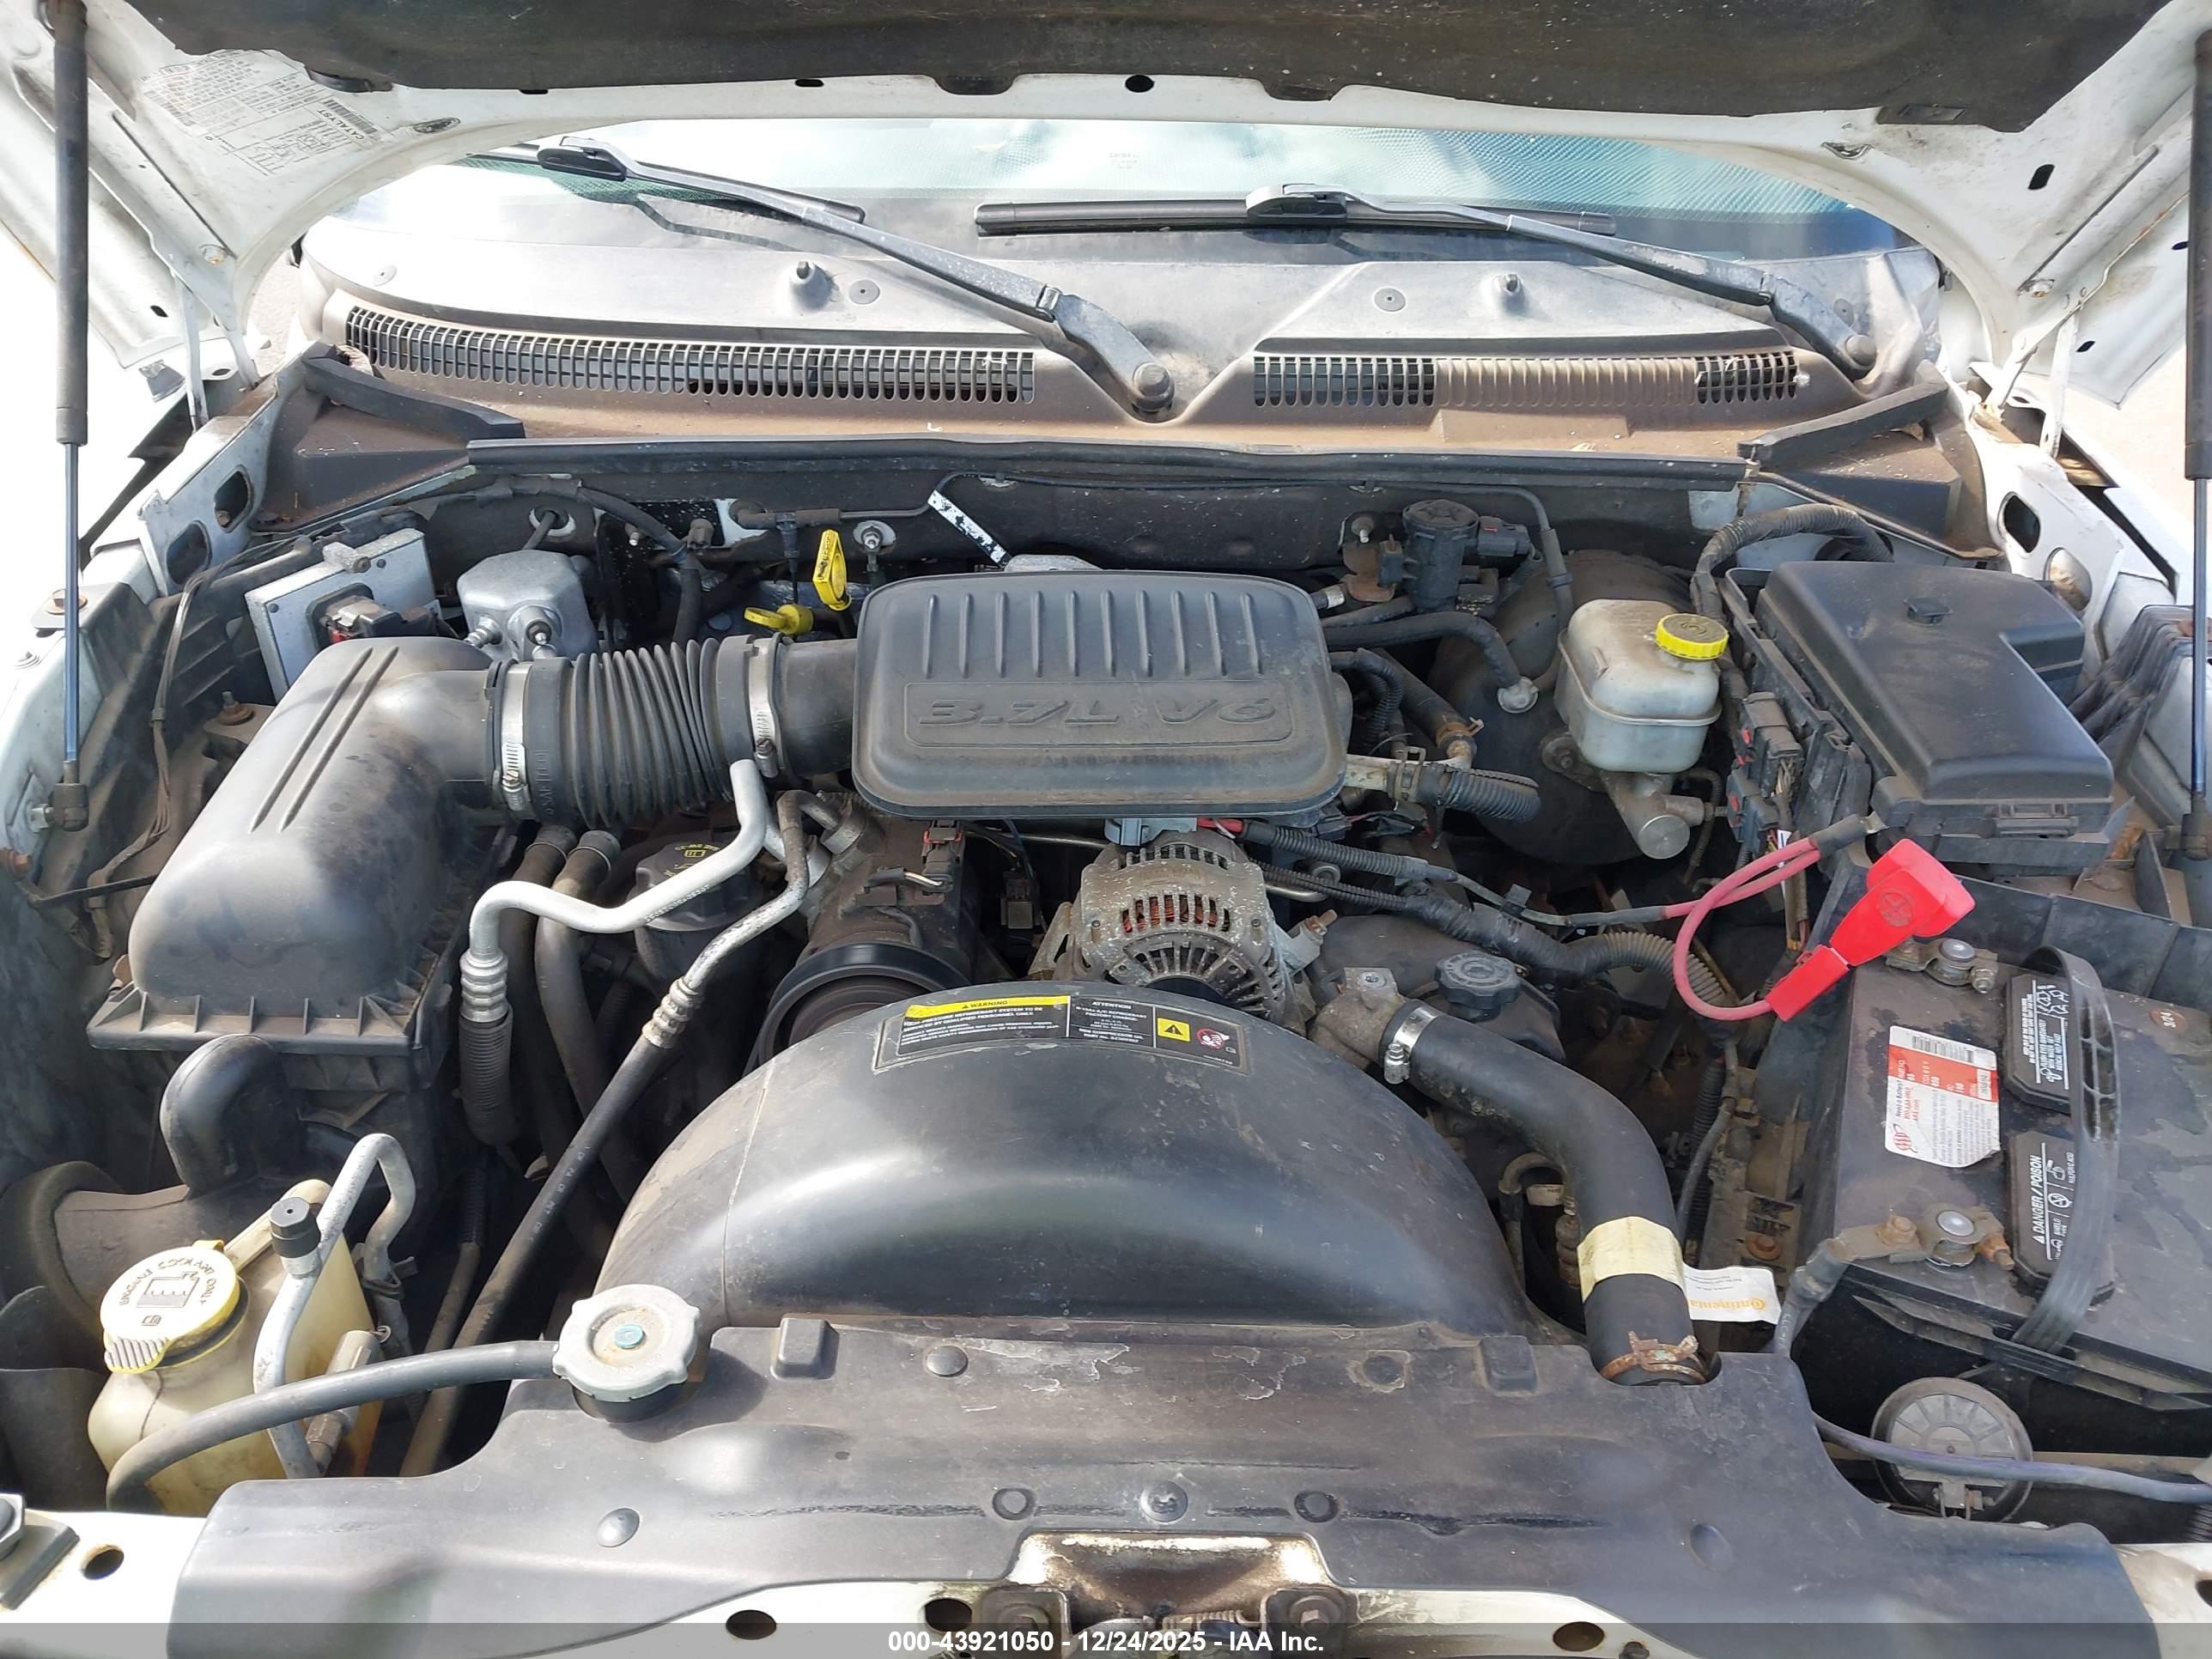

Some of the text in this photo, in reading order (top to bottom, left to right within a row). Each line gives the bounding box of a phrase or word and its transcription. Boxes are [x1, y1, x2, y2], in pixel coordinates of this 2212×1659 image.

[316, 108, 365, 140] CATALYST
[919, 696, 1279, 727] 3.7L V6
[969, 1000, 1008, 1009] WARNING
[1092, 1001, 1132, 1010] ATTENTION
[2030, 1155, 2043, 1188] POISON
[2032, 1196, 2045, 1234] DANGER
[118, 1267, 154, 1306] ENGINE
[157, 1257, 216, 1276] COOLANT
[1689, 1298, 1766, 1312] Continenta
